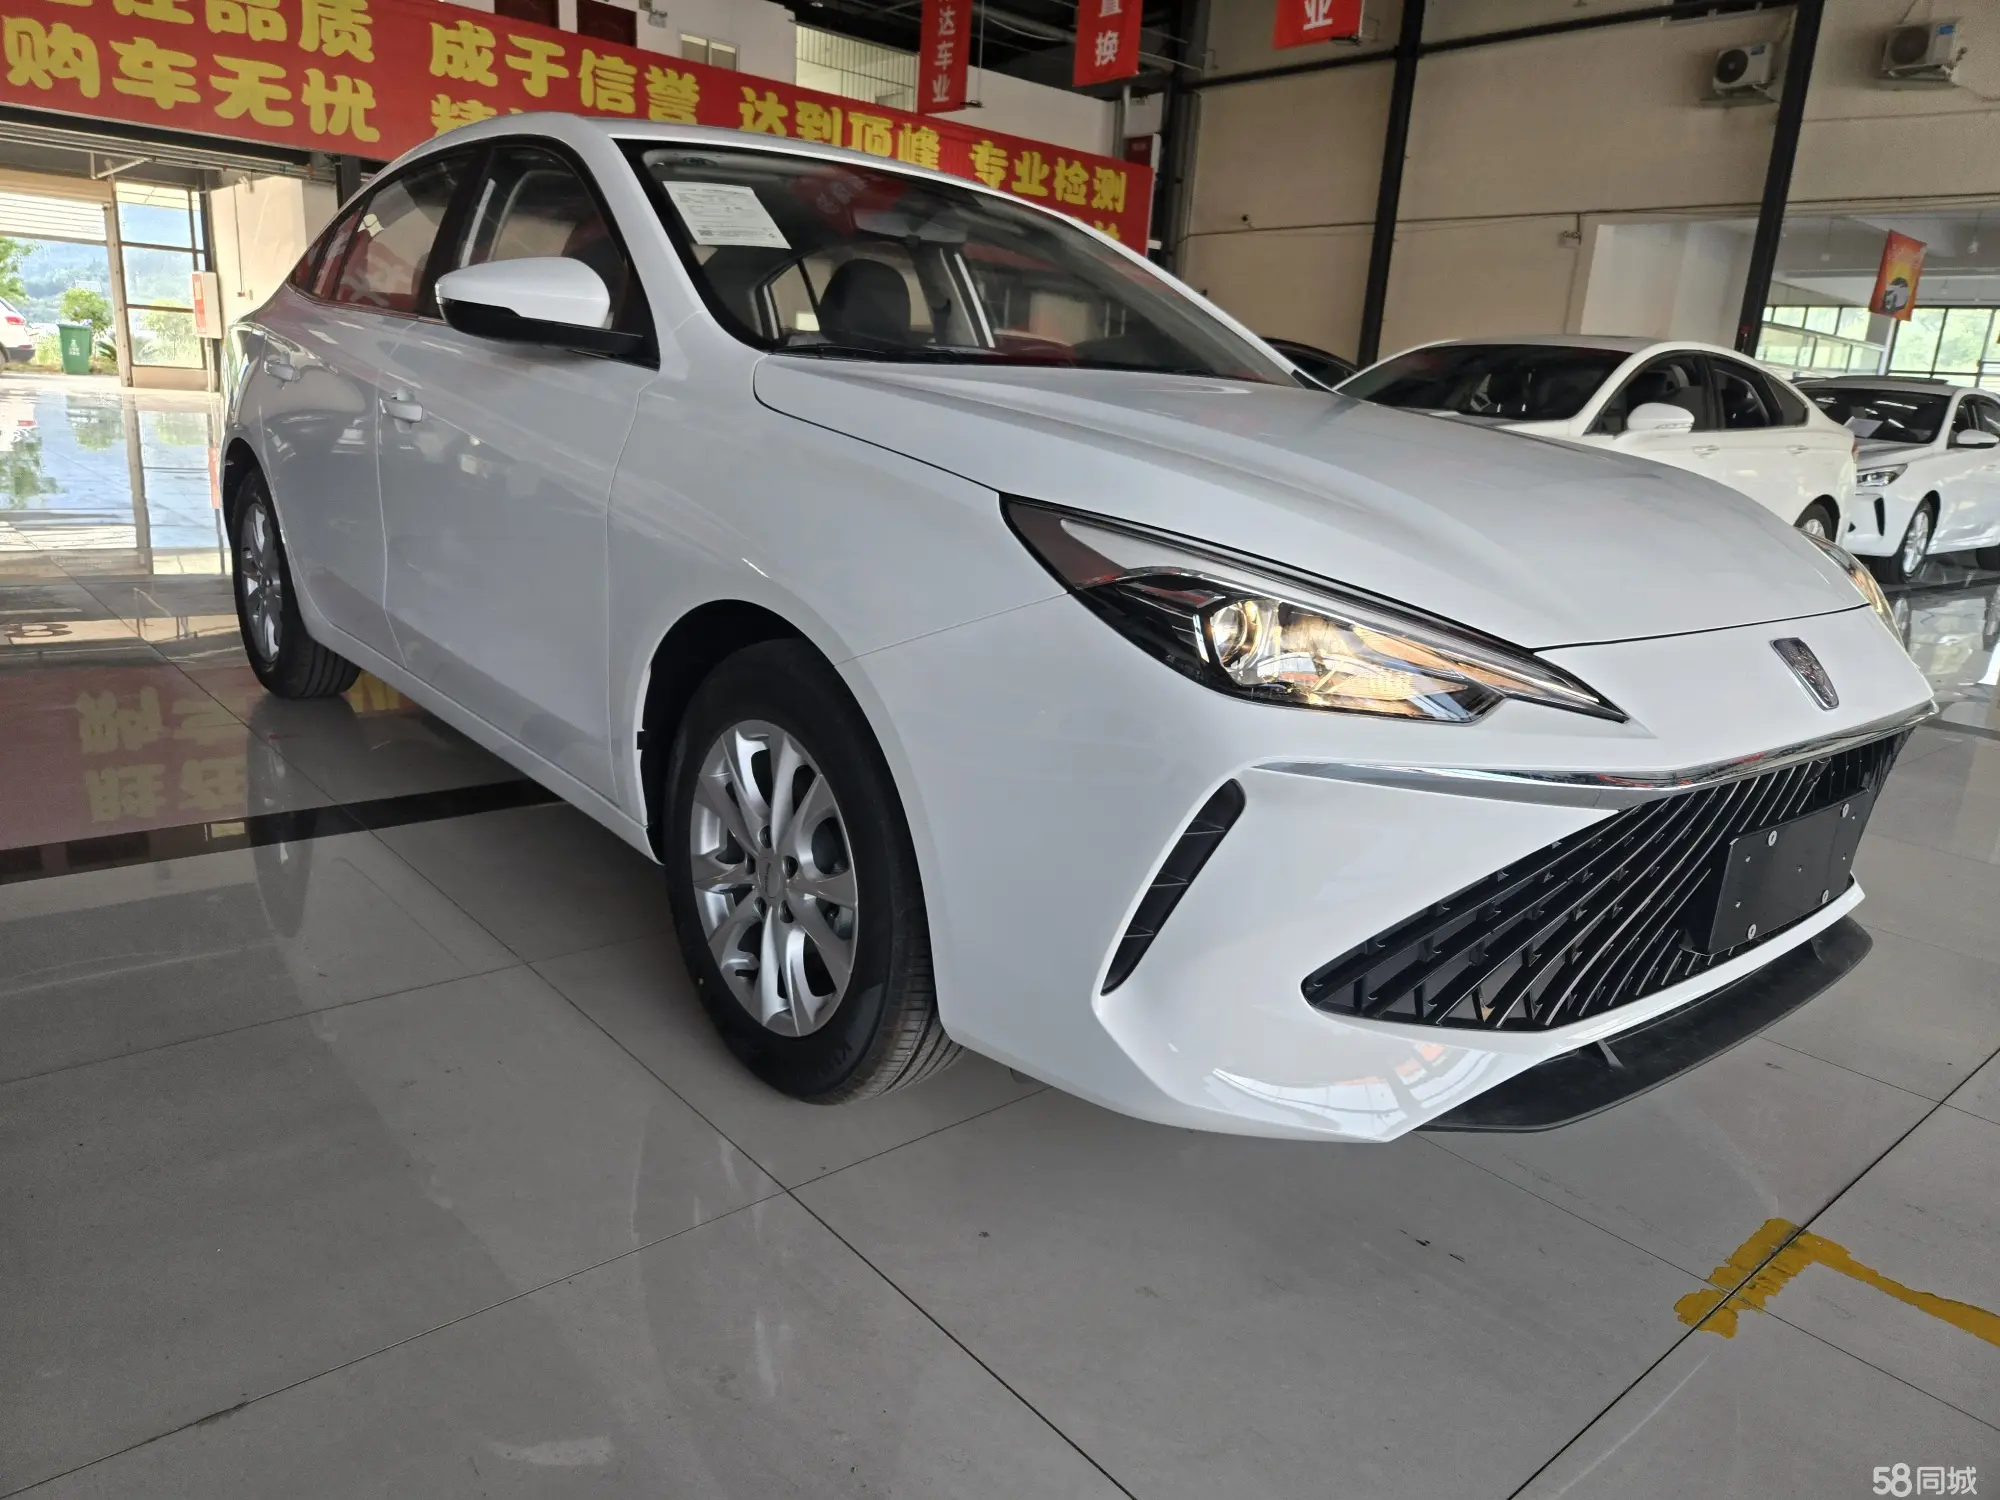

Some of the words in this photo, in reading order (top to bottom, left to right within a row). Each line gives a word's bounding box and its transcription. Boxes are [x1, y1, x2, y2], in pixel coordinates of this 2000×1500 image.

[2, 15, 381, 143] 购车无忧
[45, 0, 375, 63] 品质
[429, 20, 700, 124] 成于信誉
[738, 86, 941, 171] 达到顶峰
[968, 139, 1127, 213] 专业检测
[932, 0, 956, 103] 达车业
